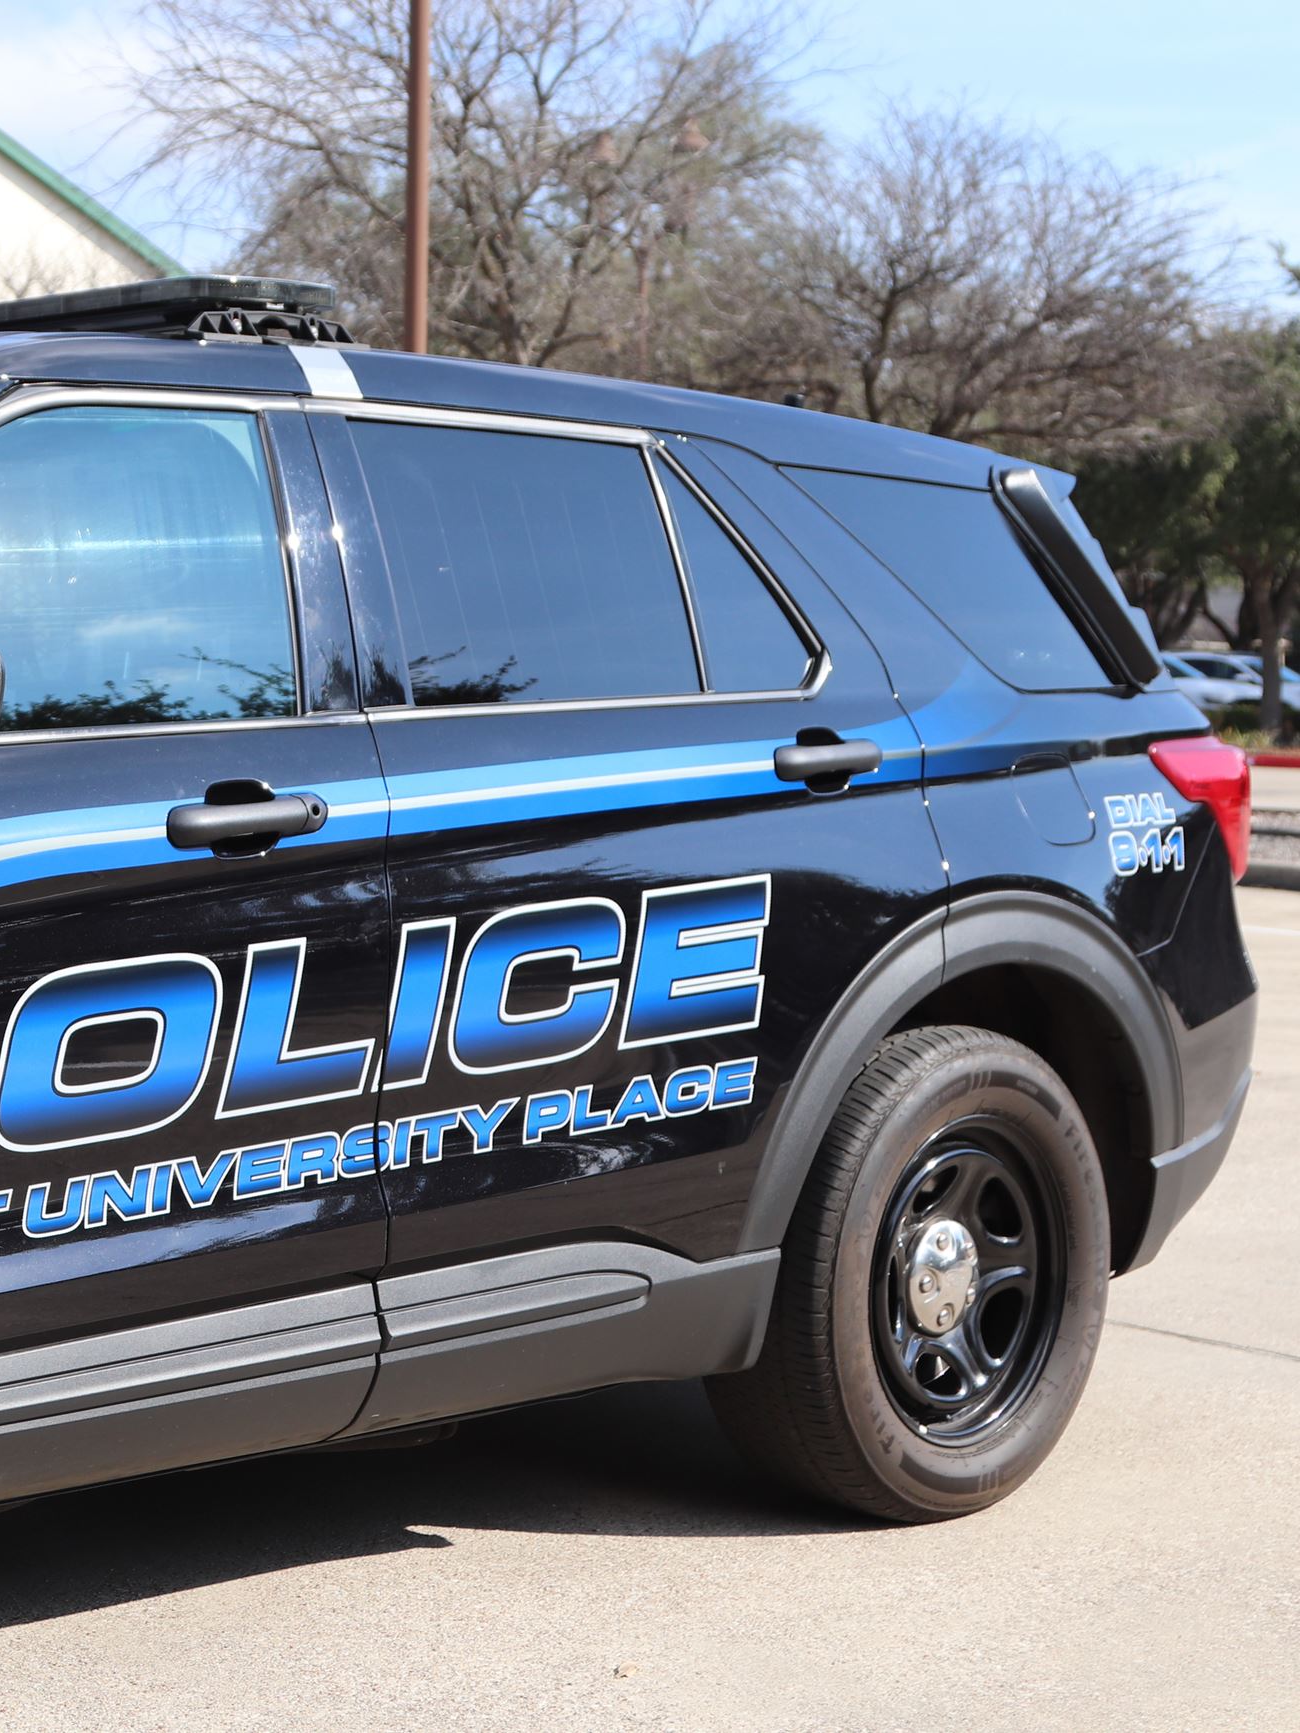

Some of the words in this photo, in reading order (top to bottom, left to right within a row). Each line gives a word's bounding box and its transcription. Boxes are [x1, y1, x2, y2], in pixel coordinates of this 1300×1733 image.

[1103, 792, 1177, 828] DIAL
[22, 1097, 521, 1239] UNIVERSITY
[522, 1056, 759, 1145] PLACE
